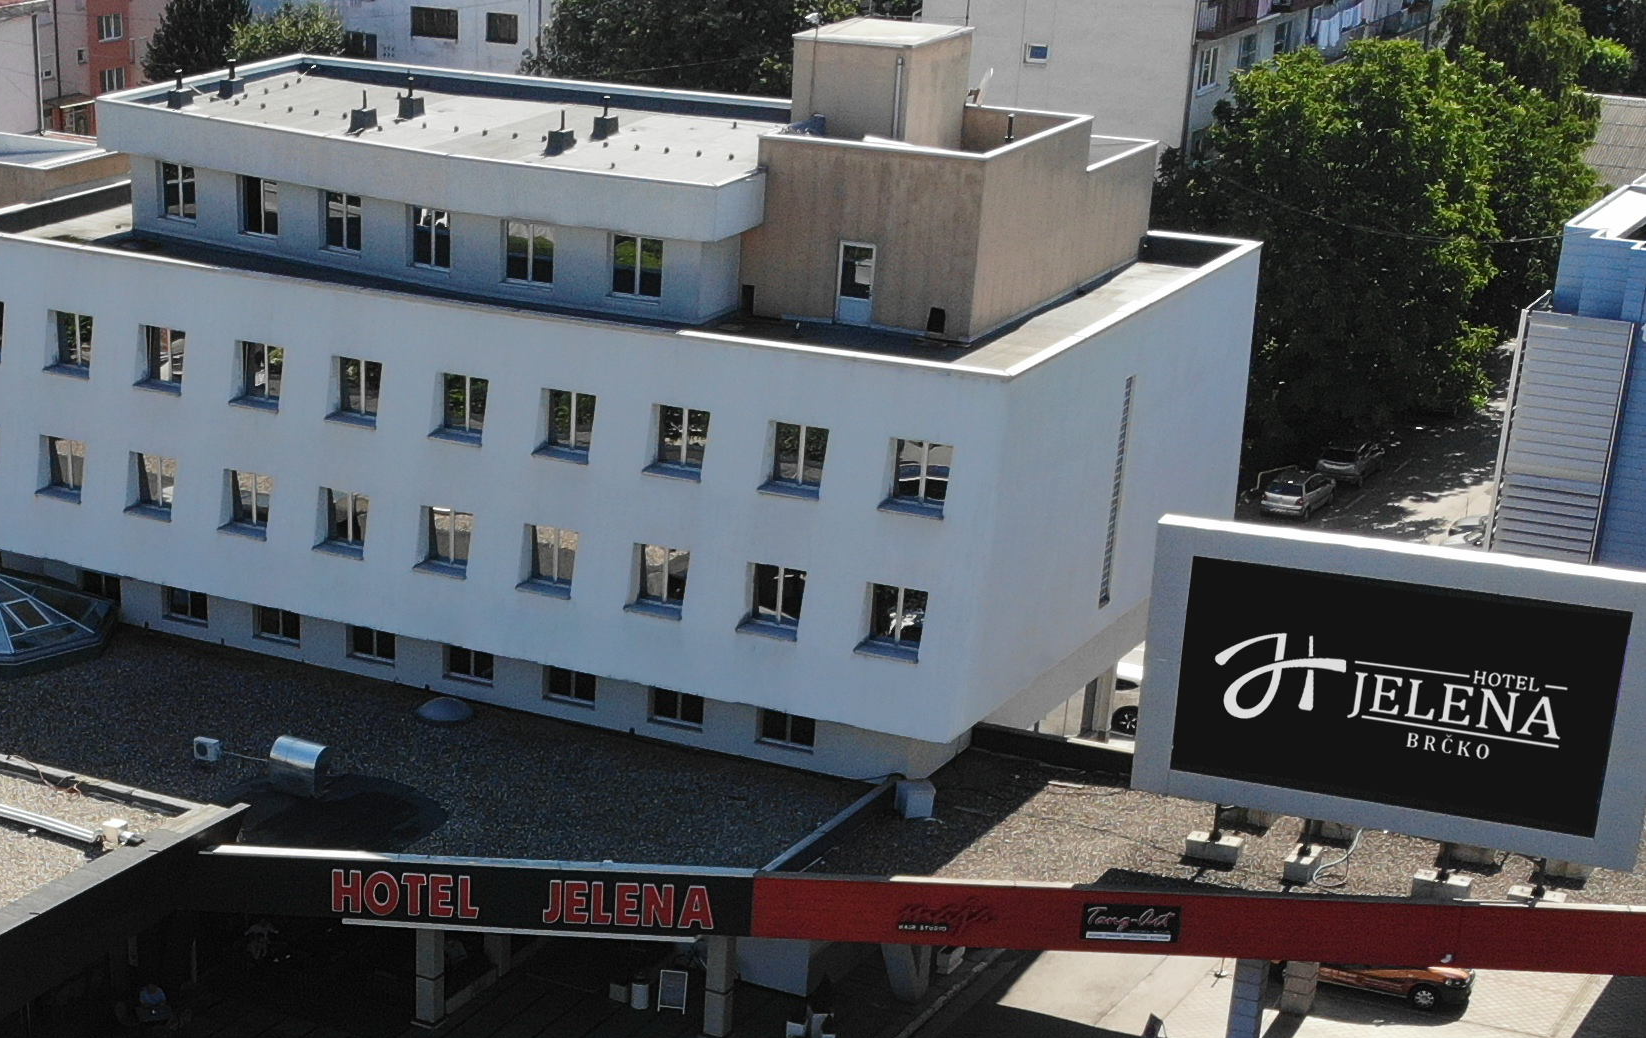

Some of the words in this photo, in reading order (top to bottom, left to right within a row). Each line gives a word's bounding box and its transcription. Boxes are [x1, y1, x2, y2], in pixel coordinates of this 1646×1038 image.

[1472, 669, 1540, 693] HOTEL
[1347, 671, 1561, 740] JELENA
[1405, 732, 1491, 760] BRČKO
[330, 868, 480, 919] HOTEL
[542, 879, 715, 930] JELENA
